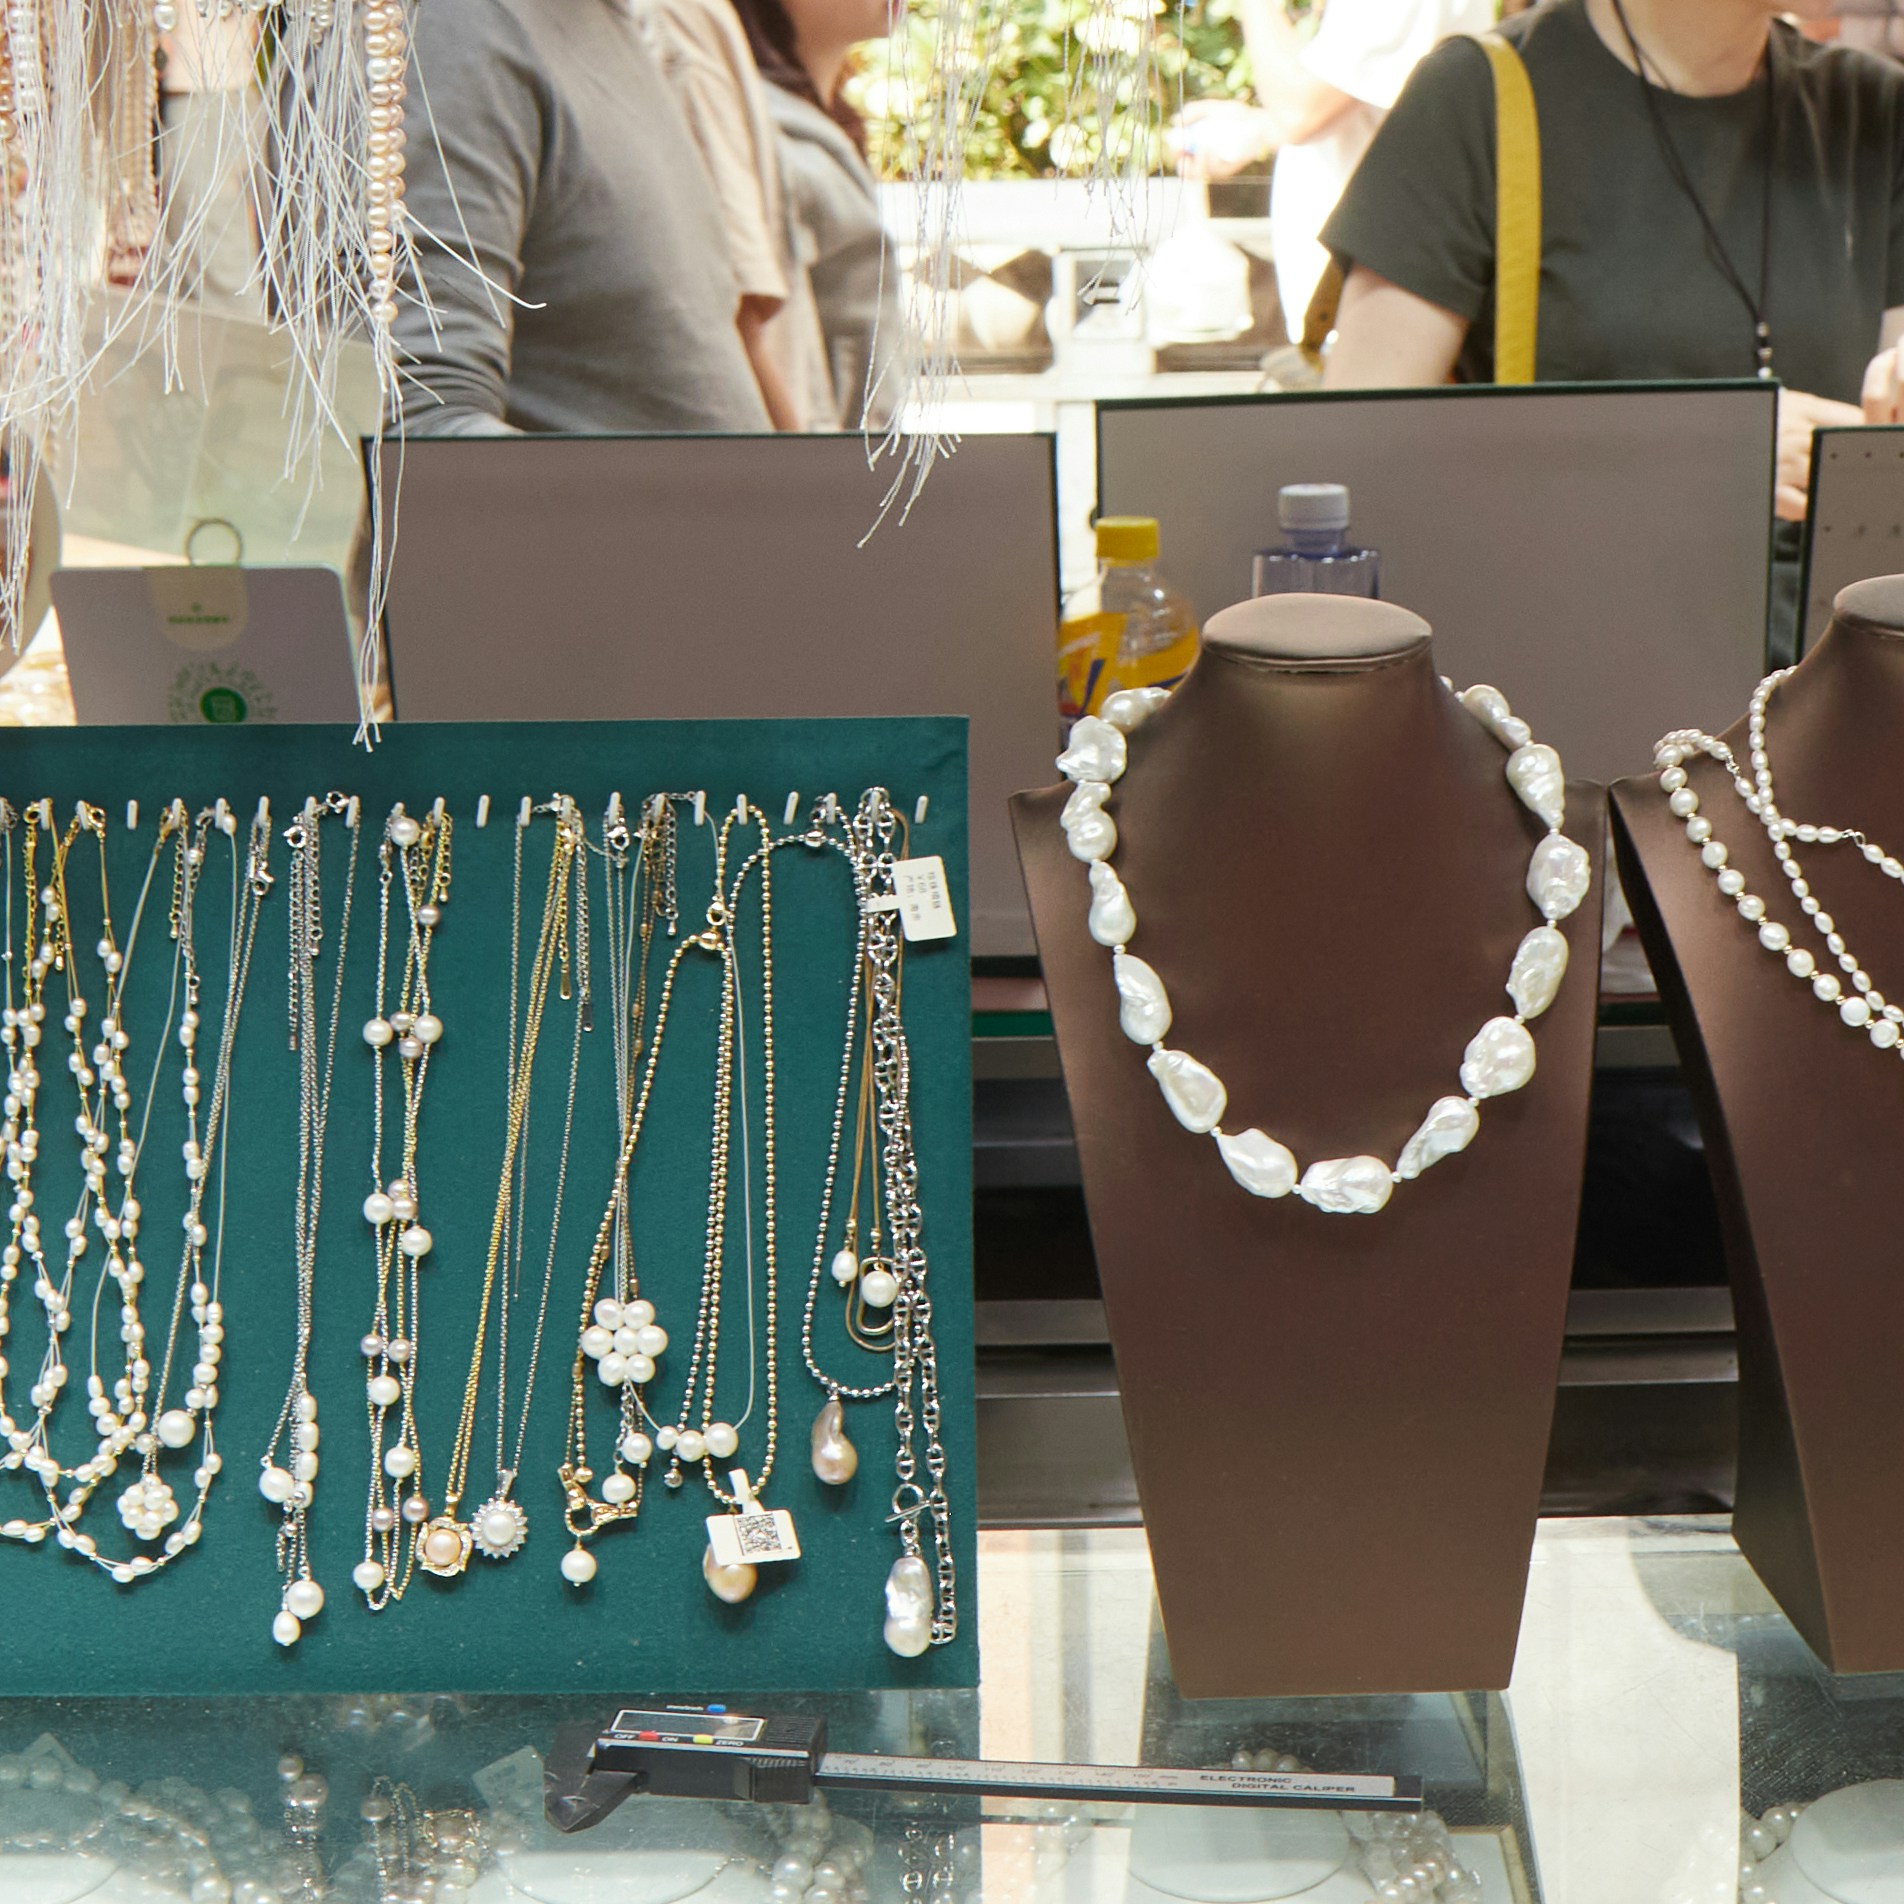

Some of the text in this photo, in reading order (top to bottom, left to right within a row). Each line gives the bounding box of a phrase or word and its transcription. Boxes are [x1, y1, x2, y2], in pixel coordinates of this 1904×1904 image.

[716, 1739, 745, 1747] ZERO
[1200, 1774, 1292, 1784] ELECTRONIC
[1231, 1782, 1356, 1793] DIGITAL CALIPER
